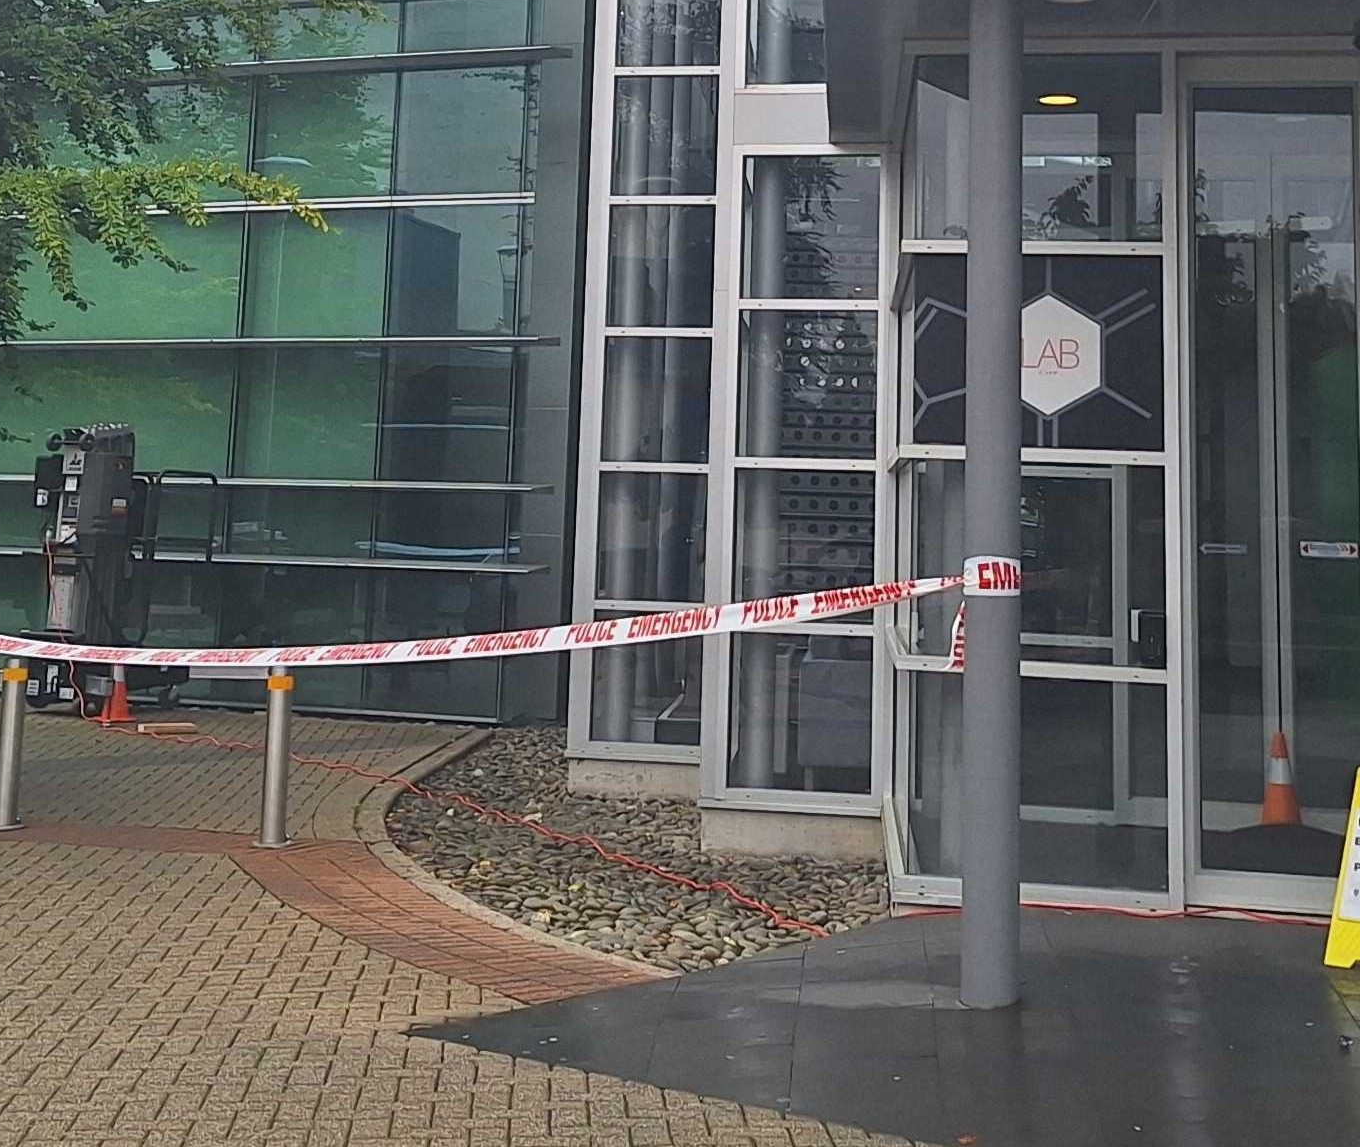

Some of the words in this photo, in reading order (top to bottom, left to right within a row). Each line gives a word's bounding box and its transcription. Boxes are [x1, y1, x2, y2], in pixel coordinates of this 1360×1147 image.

[1021, 338, 1080, 369] LAB
[564, 622, 618, 644] POLICE
[627, 606, 723, 639] EMERGENCY
[741, 595, 799, 625] POLICE
